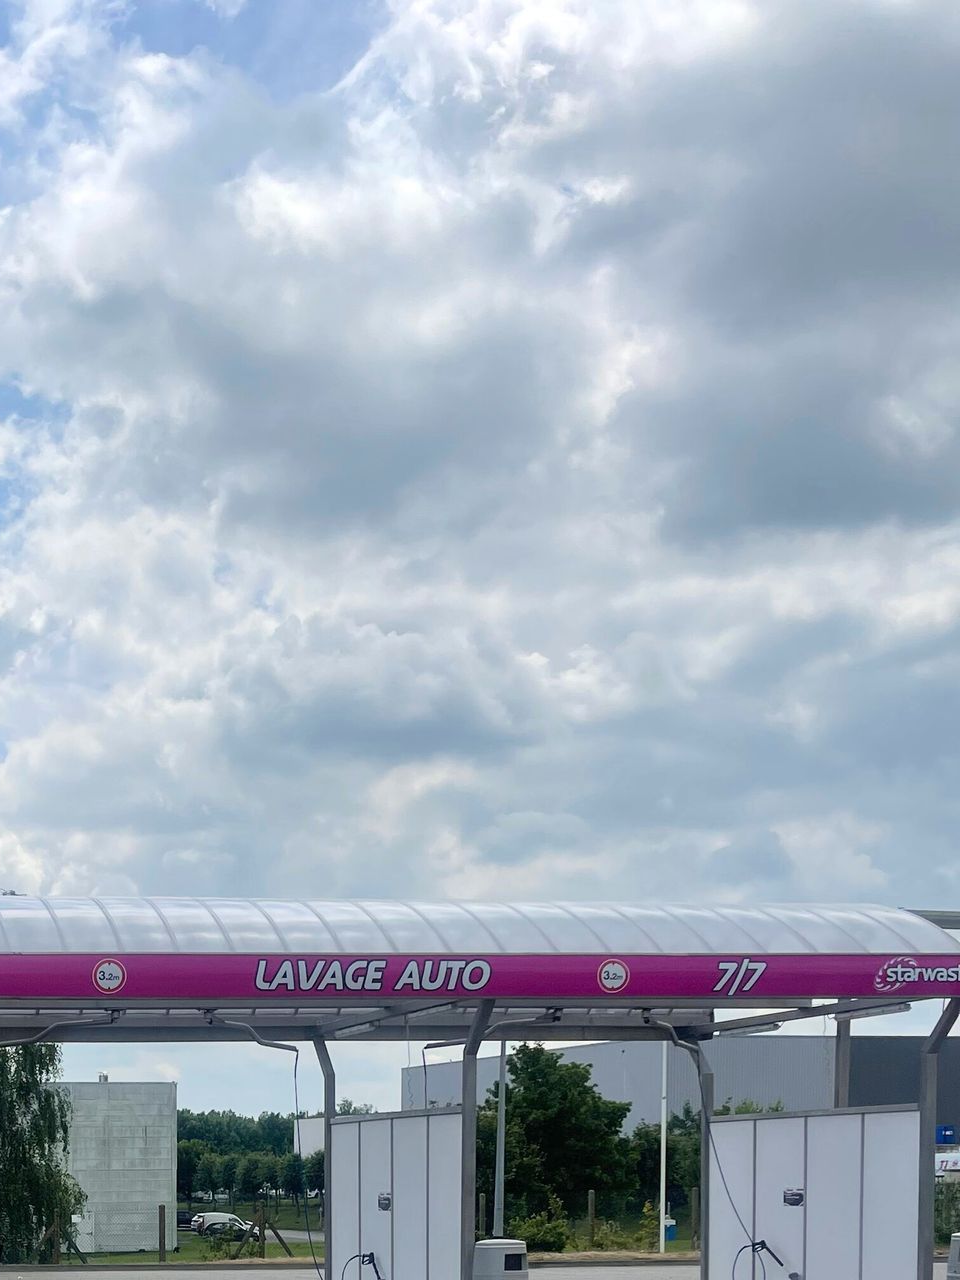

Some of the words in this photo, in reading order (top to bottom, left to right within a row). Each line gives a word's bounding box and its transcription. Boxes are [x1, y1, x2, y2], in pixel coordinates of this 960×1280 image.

[255, 960, 387, 990] LAVAGE
[394, 959, 491, 990] AUTO
[712, 958, 767, 996] 7/7
[886, 964, 960, 982] starwas
